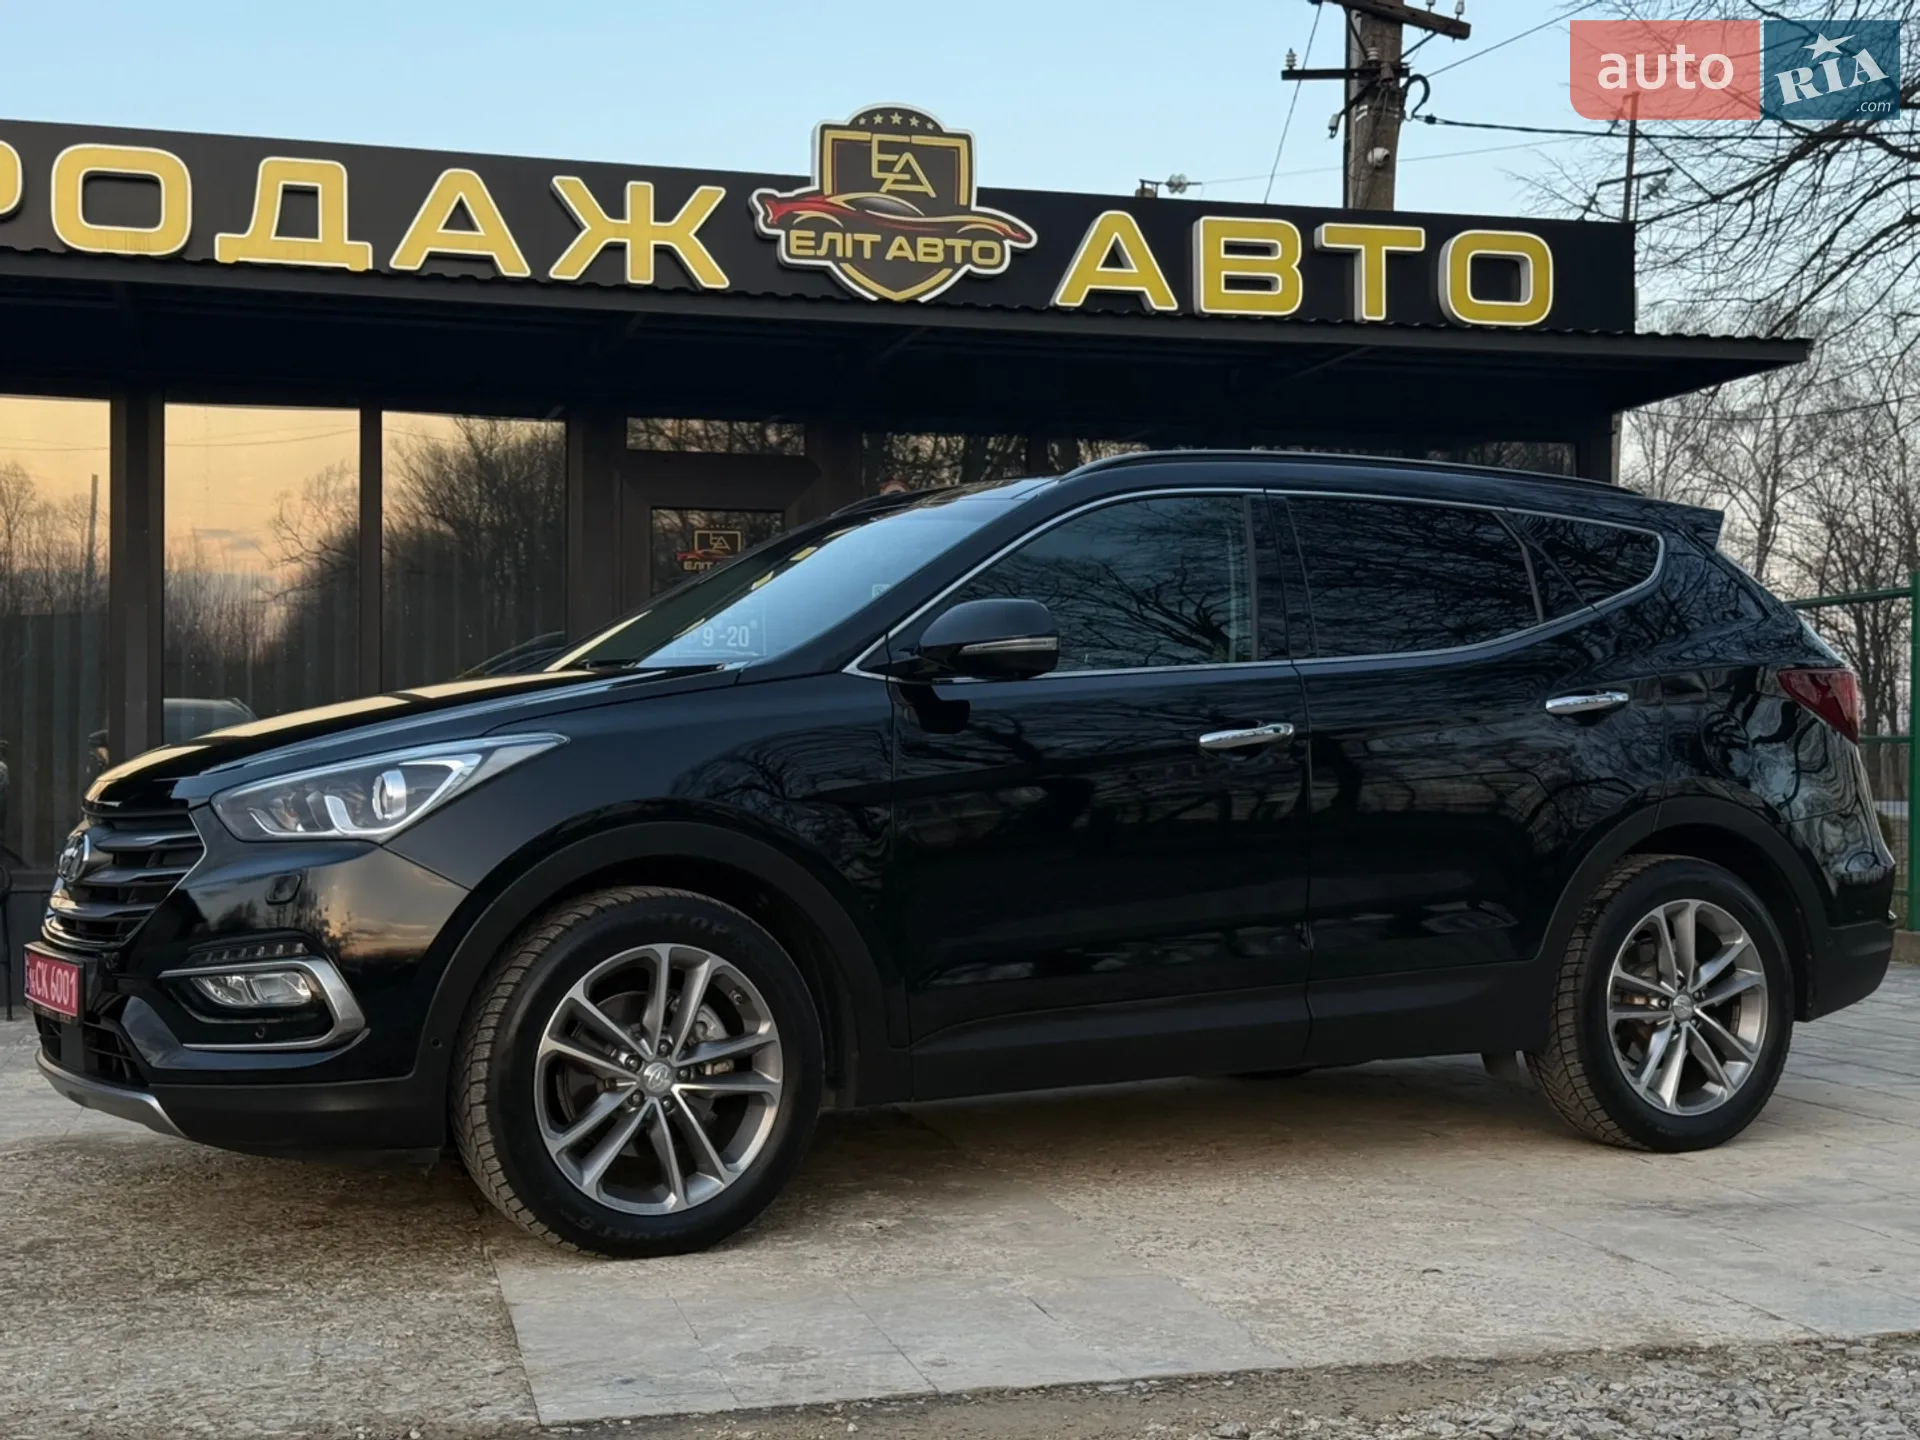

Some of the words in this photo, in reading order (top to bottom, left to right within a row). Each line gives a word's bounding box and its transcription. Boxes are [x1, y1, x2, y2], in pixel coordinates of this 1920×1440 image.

[789, 229, 881, 260] ЕЛІТ
[885, 235, 1002, 266] АВТО
[1055, 209, 1554, 327] АВТО
